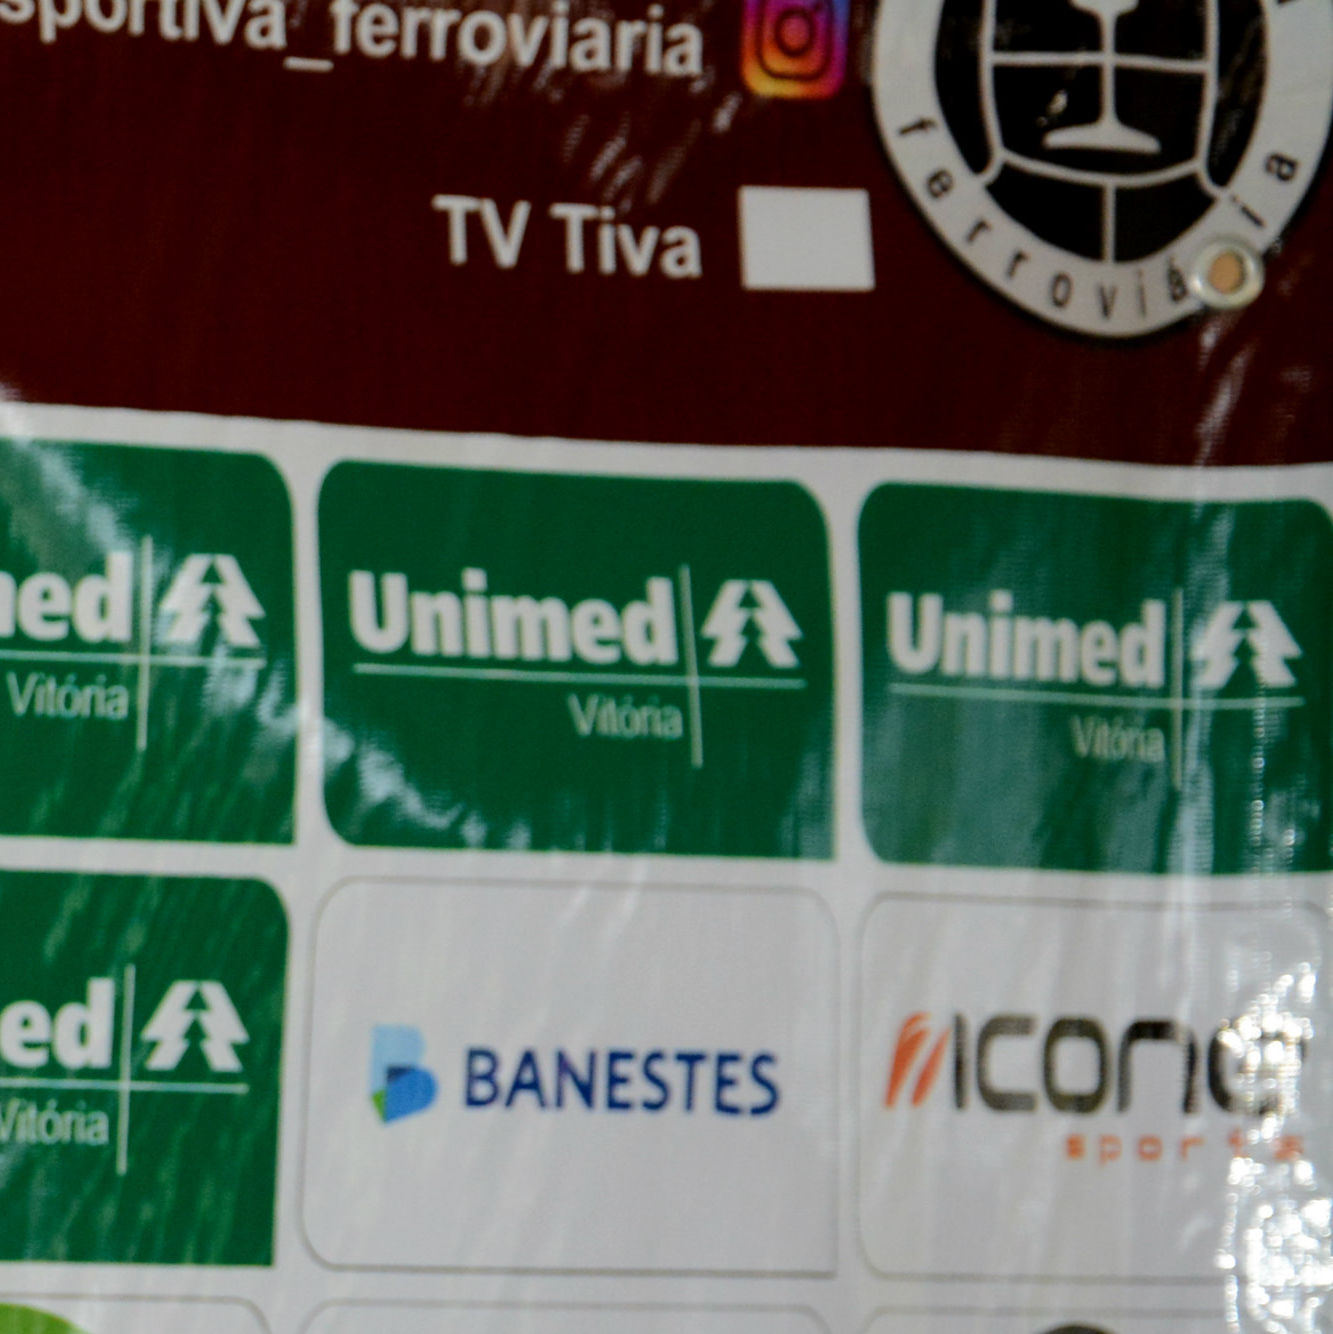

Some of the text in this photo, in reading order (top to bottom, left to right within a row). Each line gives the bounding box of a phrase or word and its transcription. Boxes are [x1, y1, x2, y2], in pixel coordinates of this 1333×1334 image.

[431, 194, 703, 279] TV Tiva
[898, 113, 1299, 321] ferroviáia
[347, 568, 678, 667] Unimed
[888, 590, 1167, 688] Unimed
[7, 671, 130, 720] Vitória
[568, 693, 684, 740] Vitória
[1071, 714, 1167, 765] Vitória
[466, 1047, 780, 1117] BANESTES
